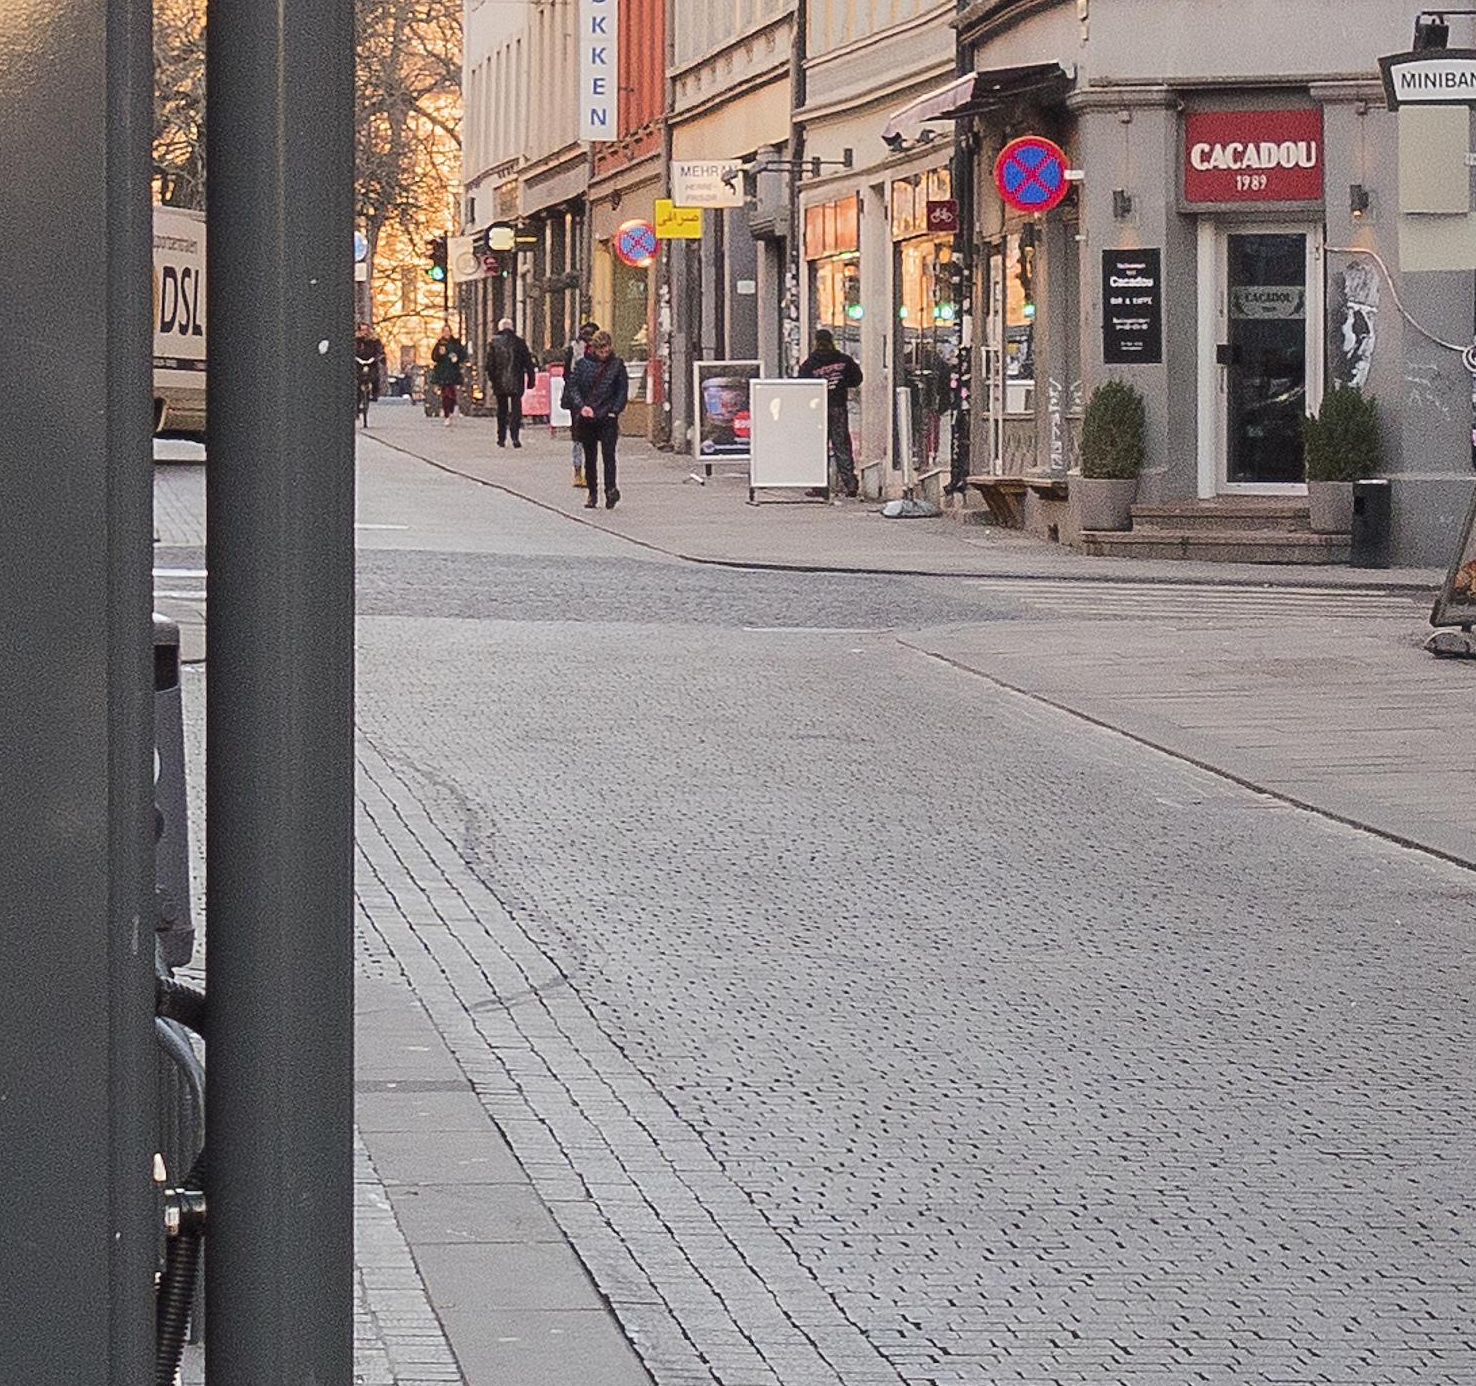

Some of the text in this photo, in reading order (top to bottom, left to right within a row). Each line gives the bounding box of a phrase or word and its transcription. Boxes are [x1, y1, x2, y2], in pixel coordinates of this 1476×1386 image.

[1190, 141, 1317, 171] CACADOU
[1236, 174, 1268, 192] 1989
[159, 266, 204, 337] DSL
